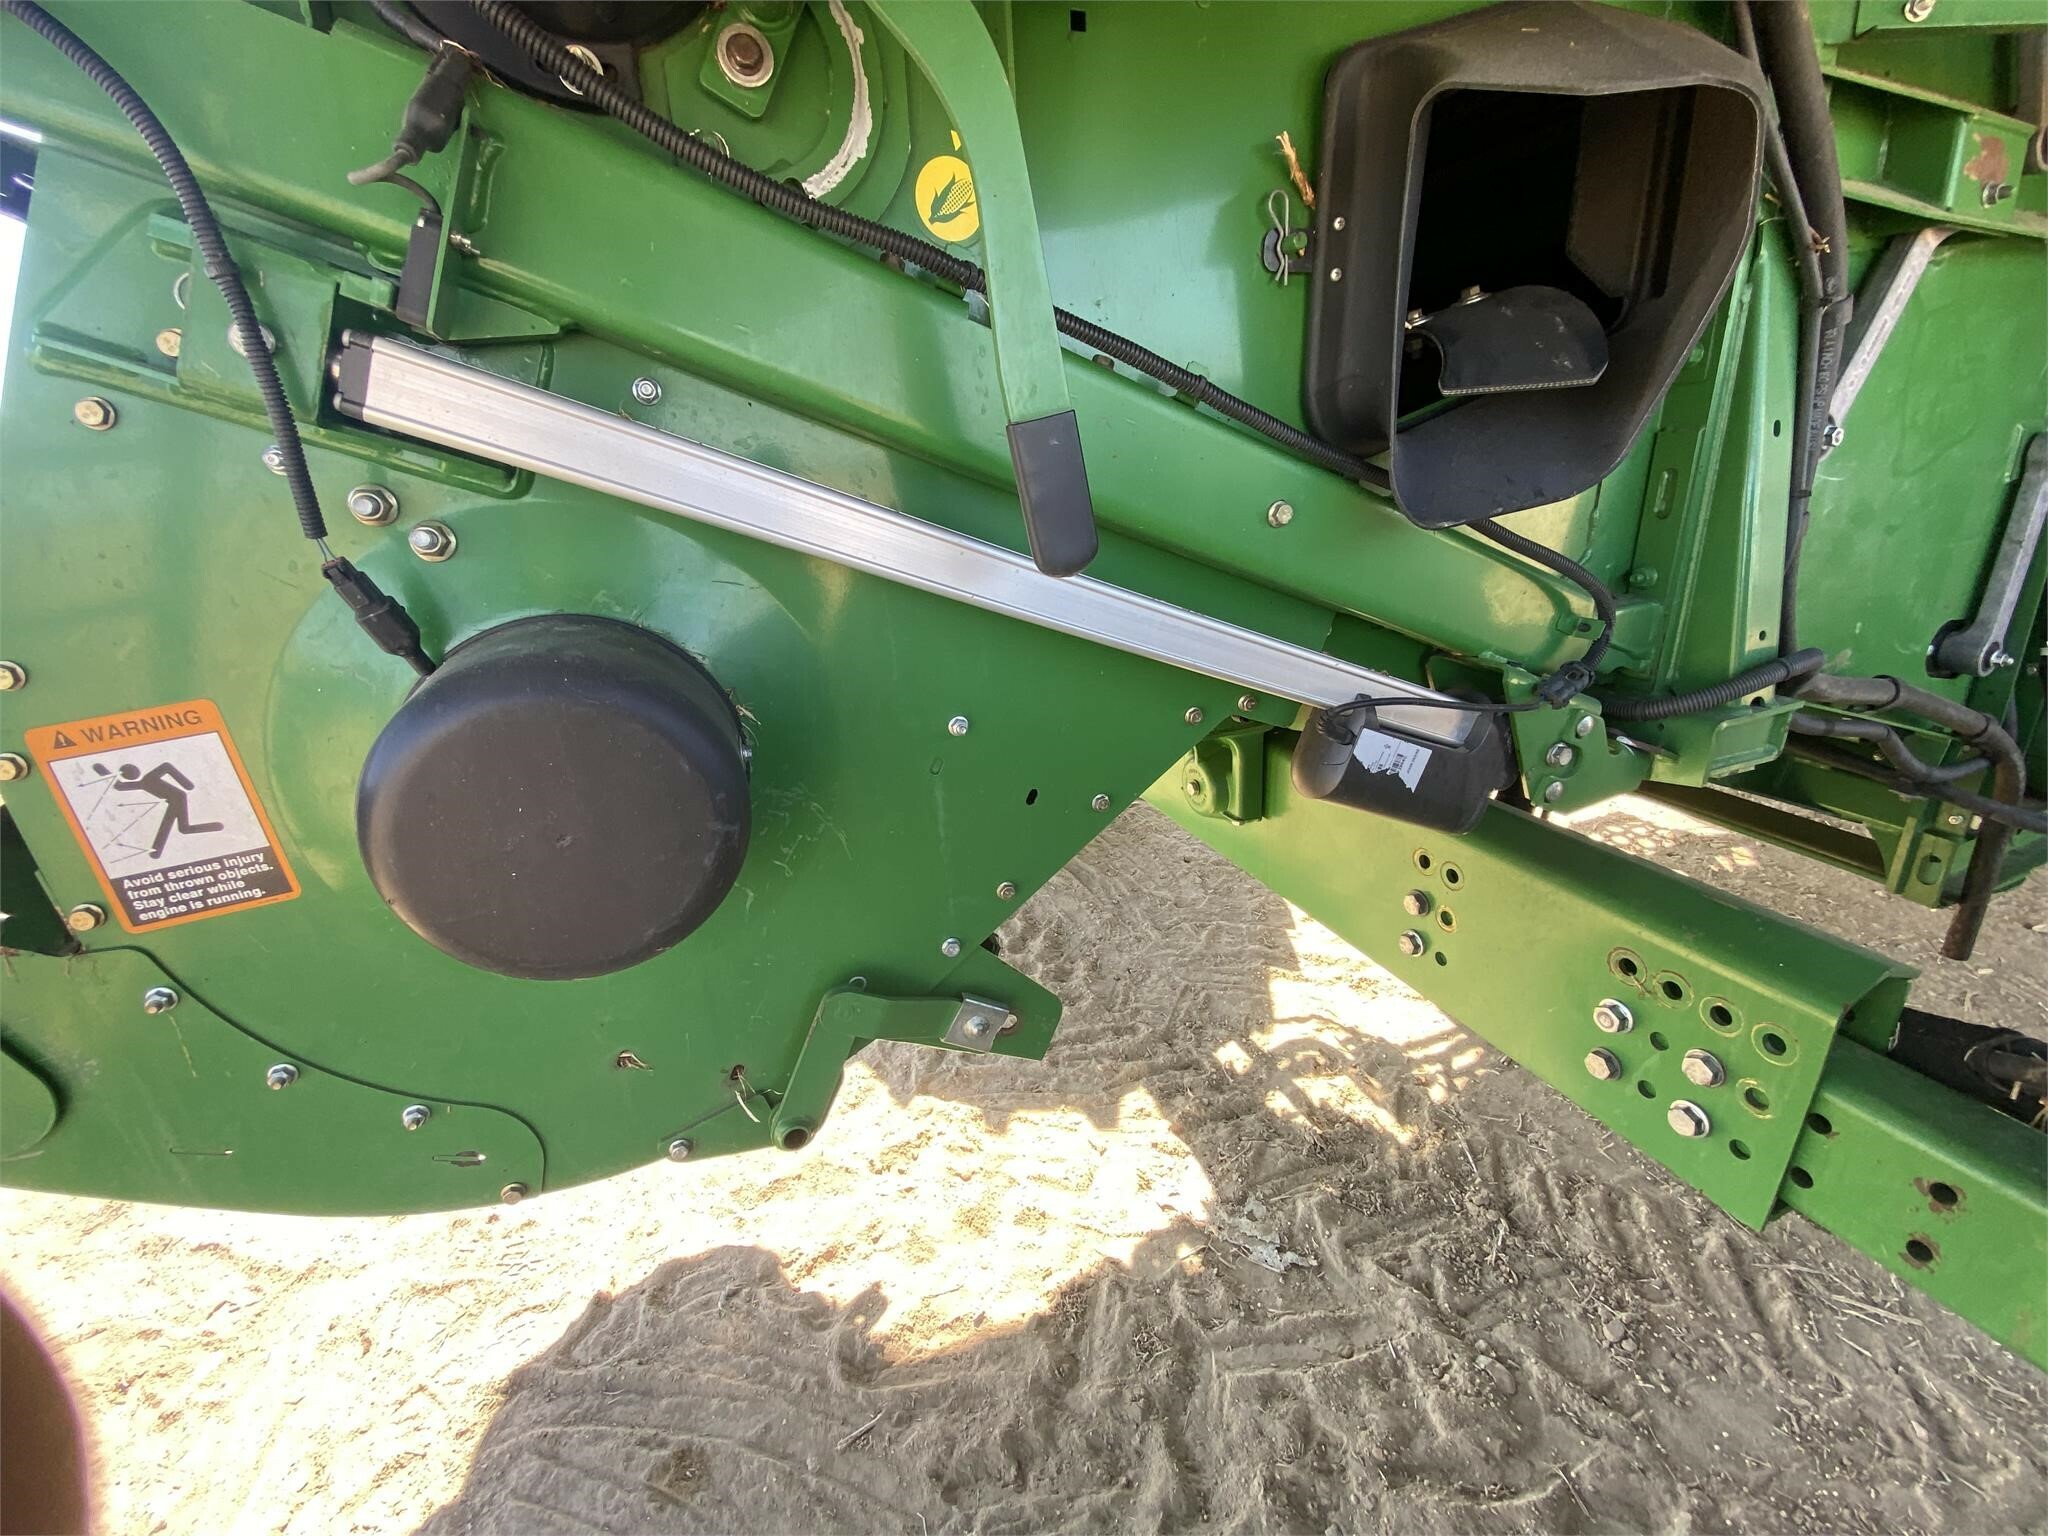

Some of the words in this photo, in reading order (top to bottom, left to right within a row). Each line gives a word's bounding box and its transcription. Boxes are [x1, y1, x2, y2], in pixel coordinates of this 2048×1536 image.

[80, 710, 203, 743] WARNING
[123, 872, 164, 889] Avoid
[167, 861, 222, 880] serious
[223, 852, 264, 869] injury
[127, 886, 162, 900] from
[164, 874, 215, 893] thrown
[218, 863, 274, 881] objects.
[132, 894, 165, 911] Stay
[167, 887, 204, 903] clear
[206, 879, 246, 895] while
[138, 902, 188, 921] engine
[190, 900, 205, 910] is
[206, 887, 266, 906] running.
